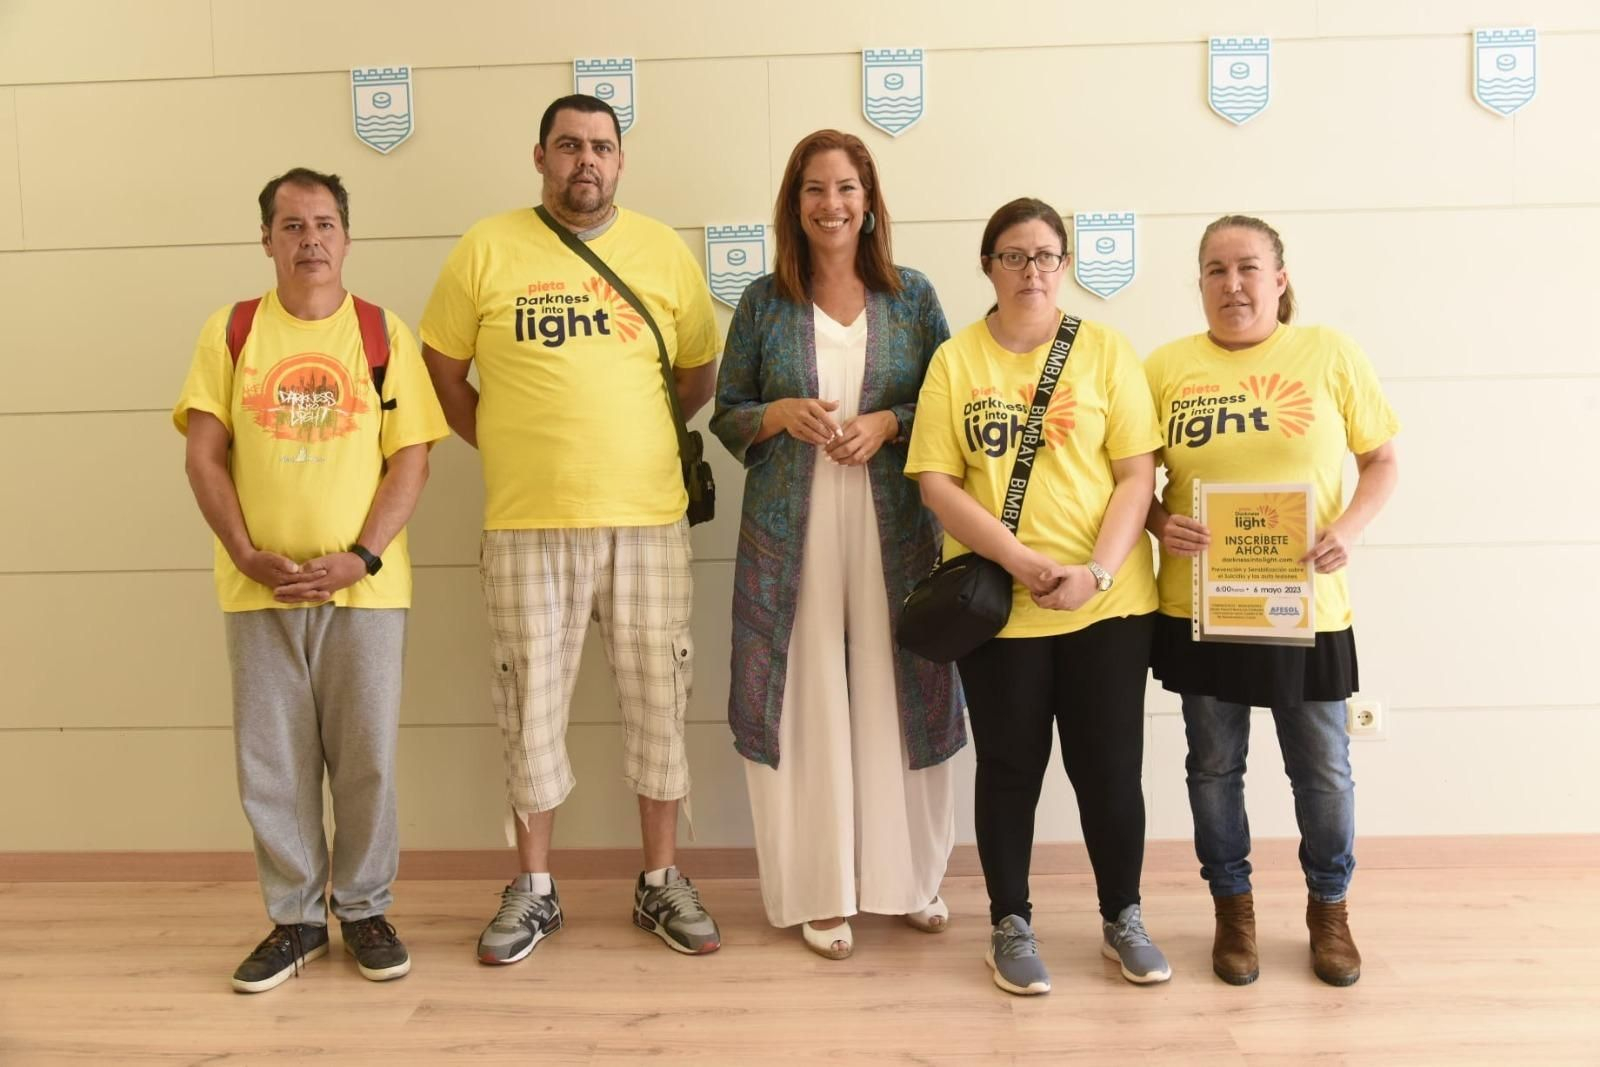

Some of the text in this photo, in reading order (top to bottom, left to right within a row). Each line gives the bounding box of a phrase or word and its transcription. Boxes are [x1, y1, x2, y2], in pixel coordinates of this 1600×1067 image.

[527, 281, 565, 295] pieta
[515, 294, 590, 306] Darkness
[541, 306, 564, 314] into
[515, 307, 611, 348] light
[1182, 384, 1220, 399] pieta
[1171, 394, 1247, 413] Darkness
[985, 410, 1008, 420] into
[1191, 407, 1216, 417] into
[1002, 316, 1079, 530] AY BIMBAY BIMBAY BIMBA
[1167, 406, 1270, 449] light
[964, 414, 1046, 458] ligh
[1235, 516, 1266, 531] light
[1225, 533, 1289, 545] INSCRÍBETE
[1235, 546, 1279, 555] AHORA
[1261, 587, 1282, 595] mayo
[1284, 586, 1302, 594] 2023
